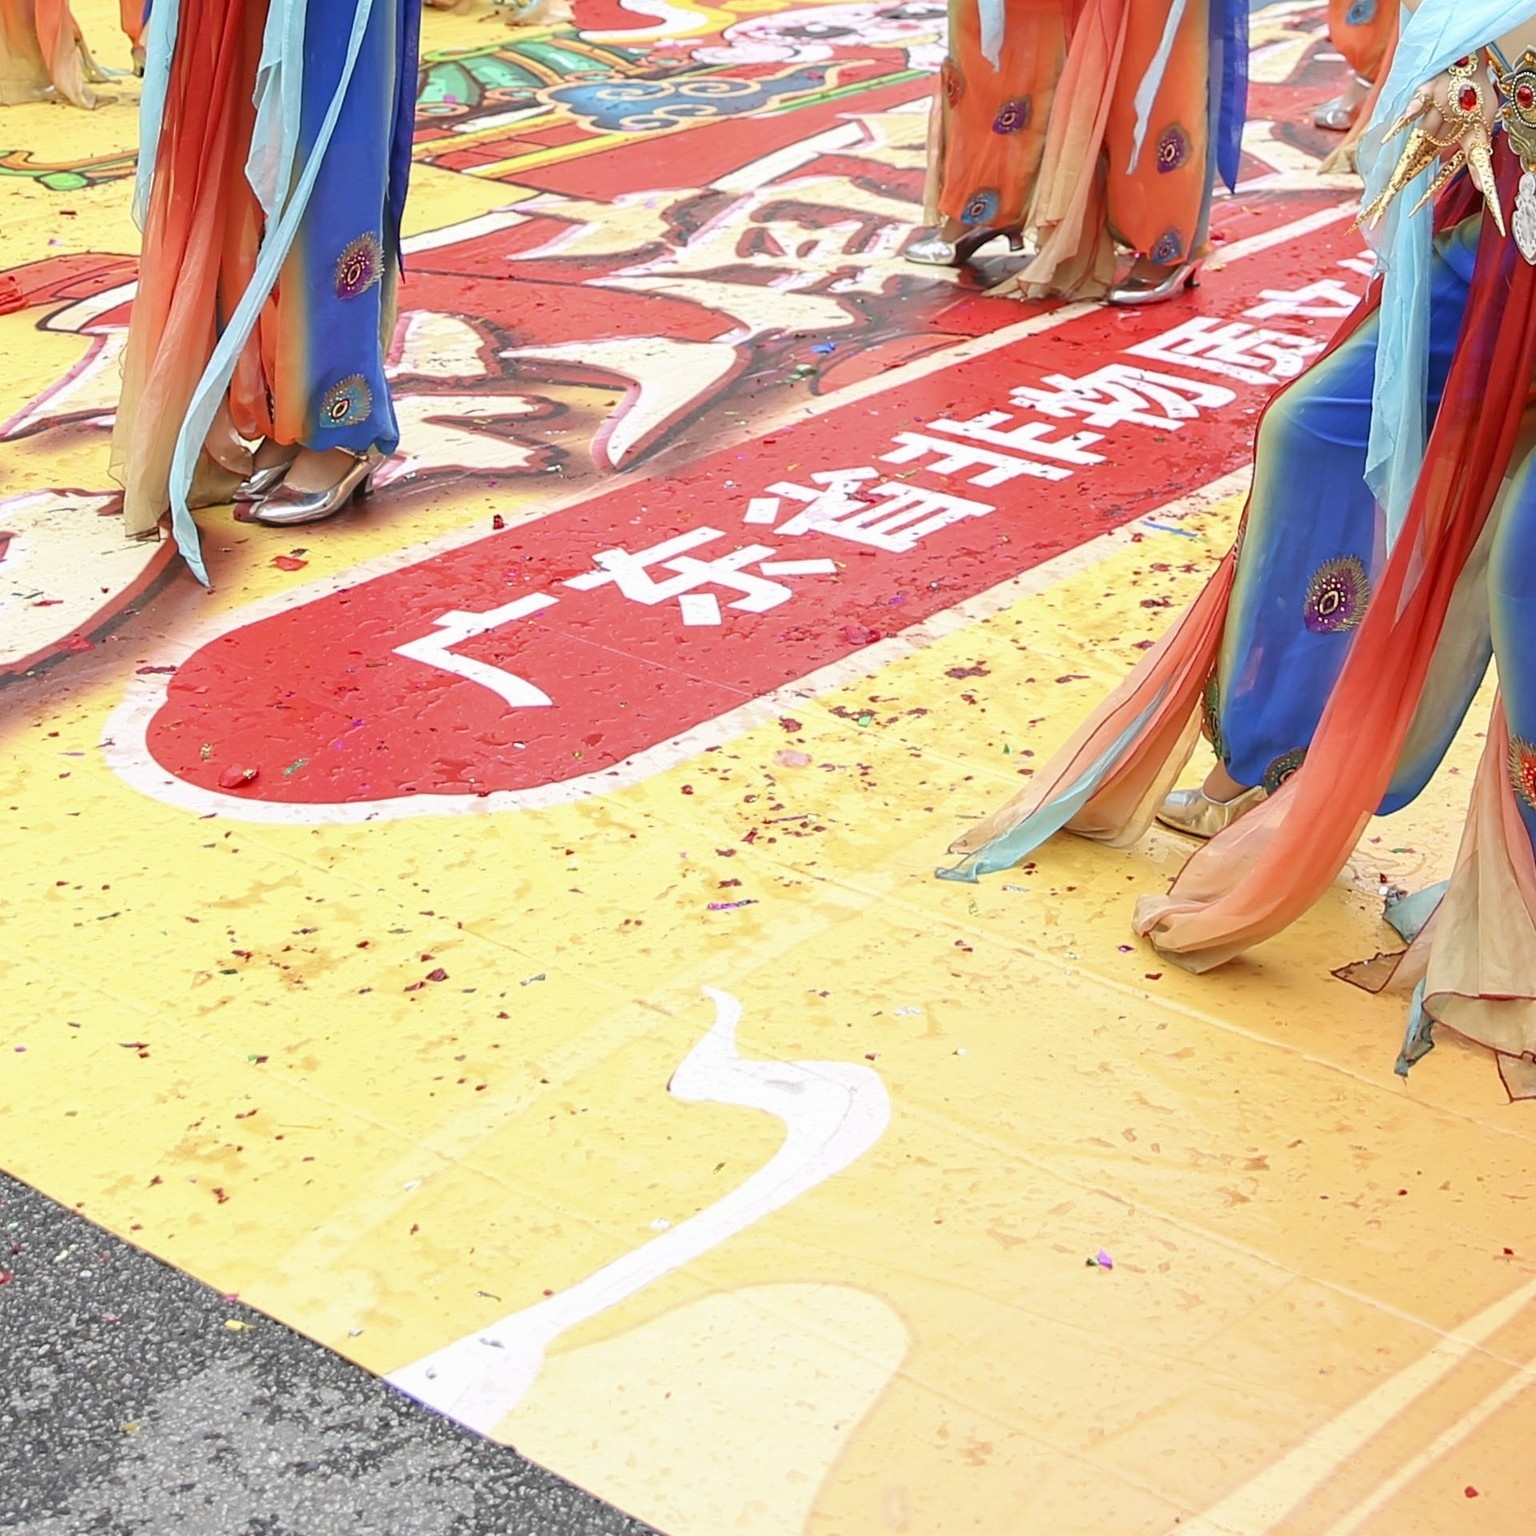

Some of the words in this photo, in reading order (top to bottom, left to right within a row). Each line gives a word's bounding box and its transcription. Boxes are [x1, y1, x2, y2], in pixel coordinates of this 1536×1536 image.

[394, 249, 1379, 709] 广东省非物质文
